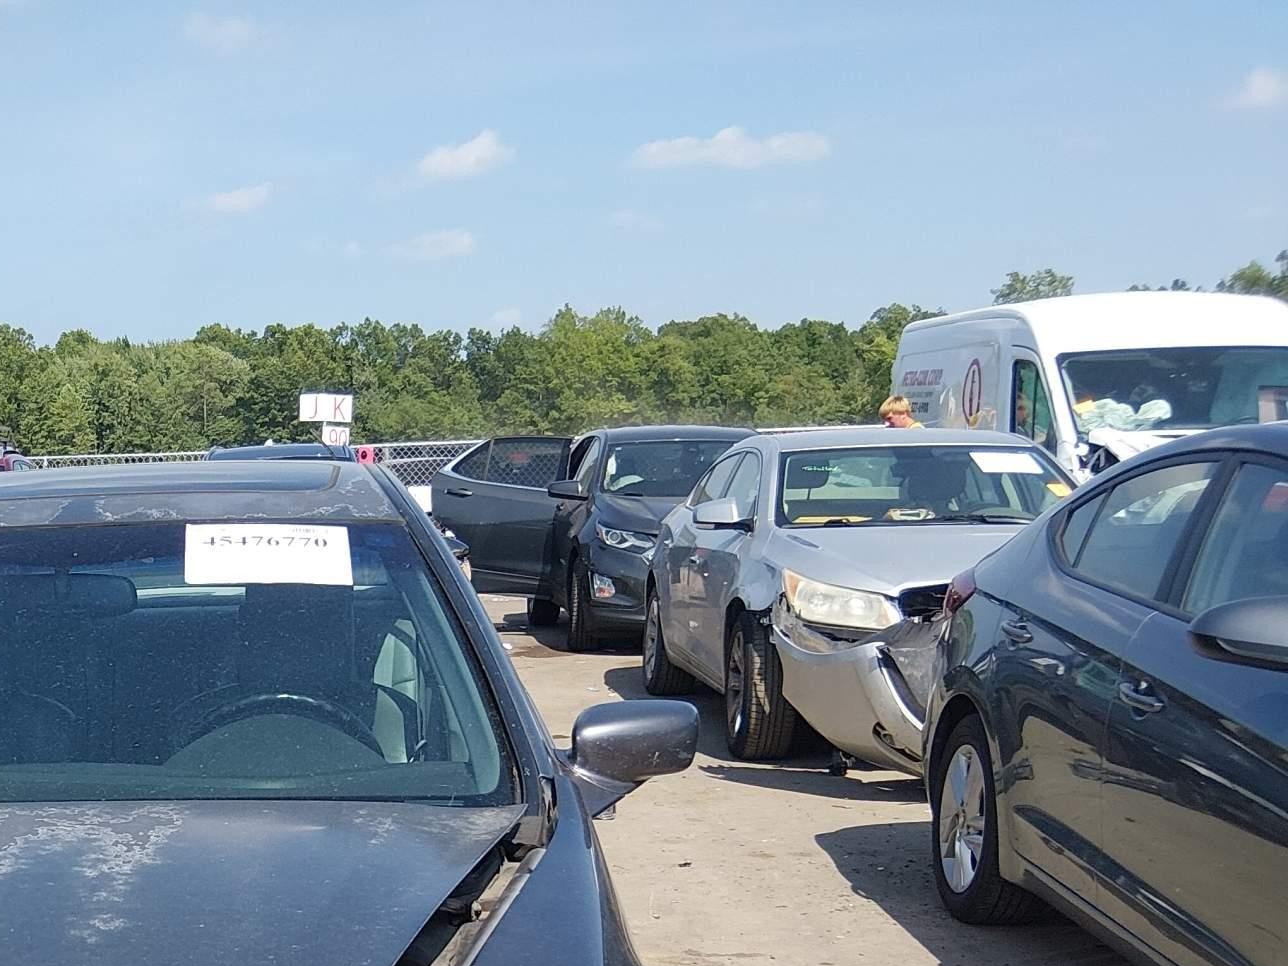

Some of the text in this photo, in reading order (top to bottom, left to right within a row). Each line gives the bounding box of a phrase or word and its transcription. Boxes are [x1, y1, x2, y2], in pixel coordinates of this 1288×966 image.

[308, 396, 346, 420] J K
[202, 535, 328, 548] 45476770
